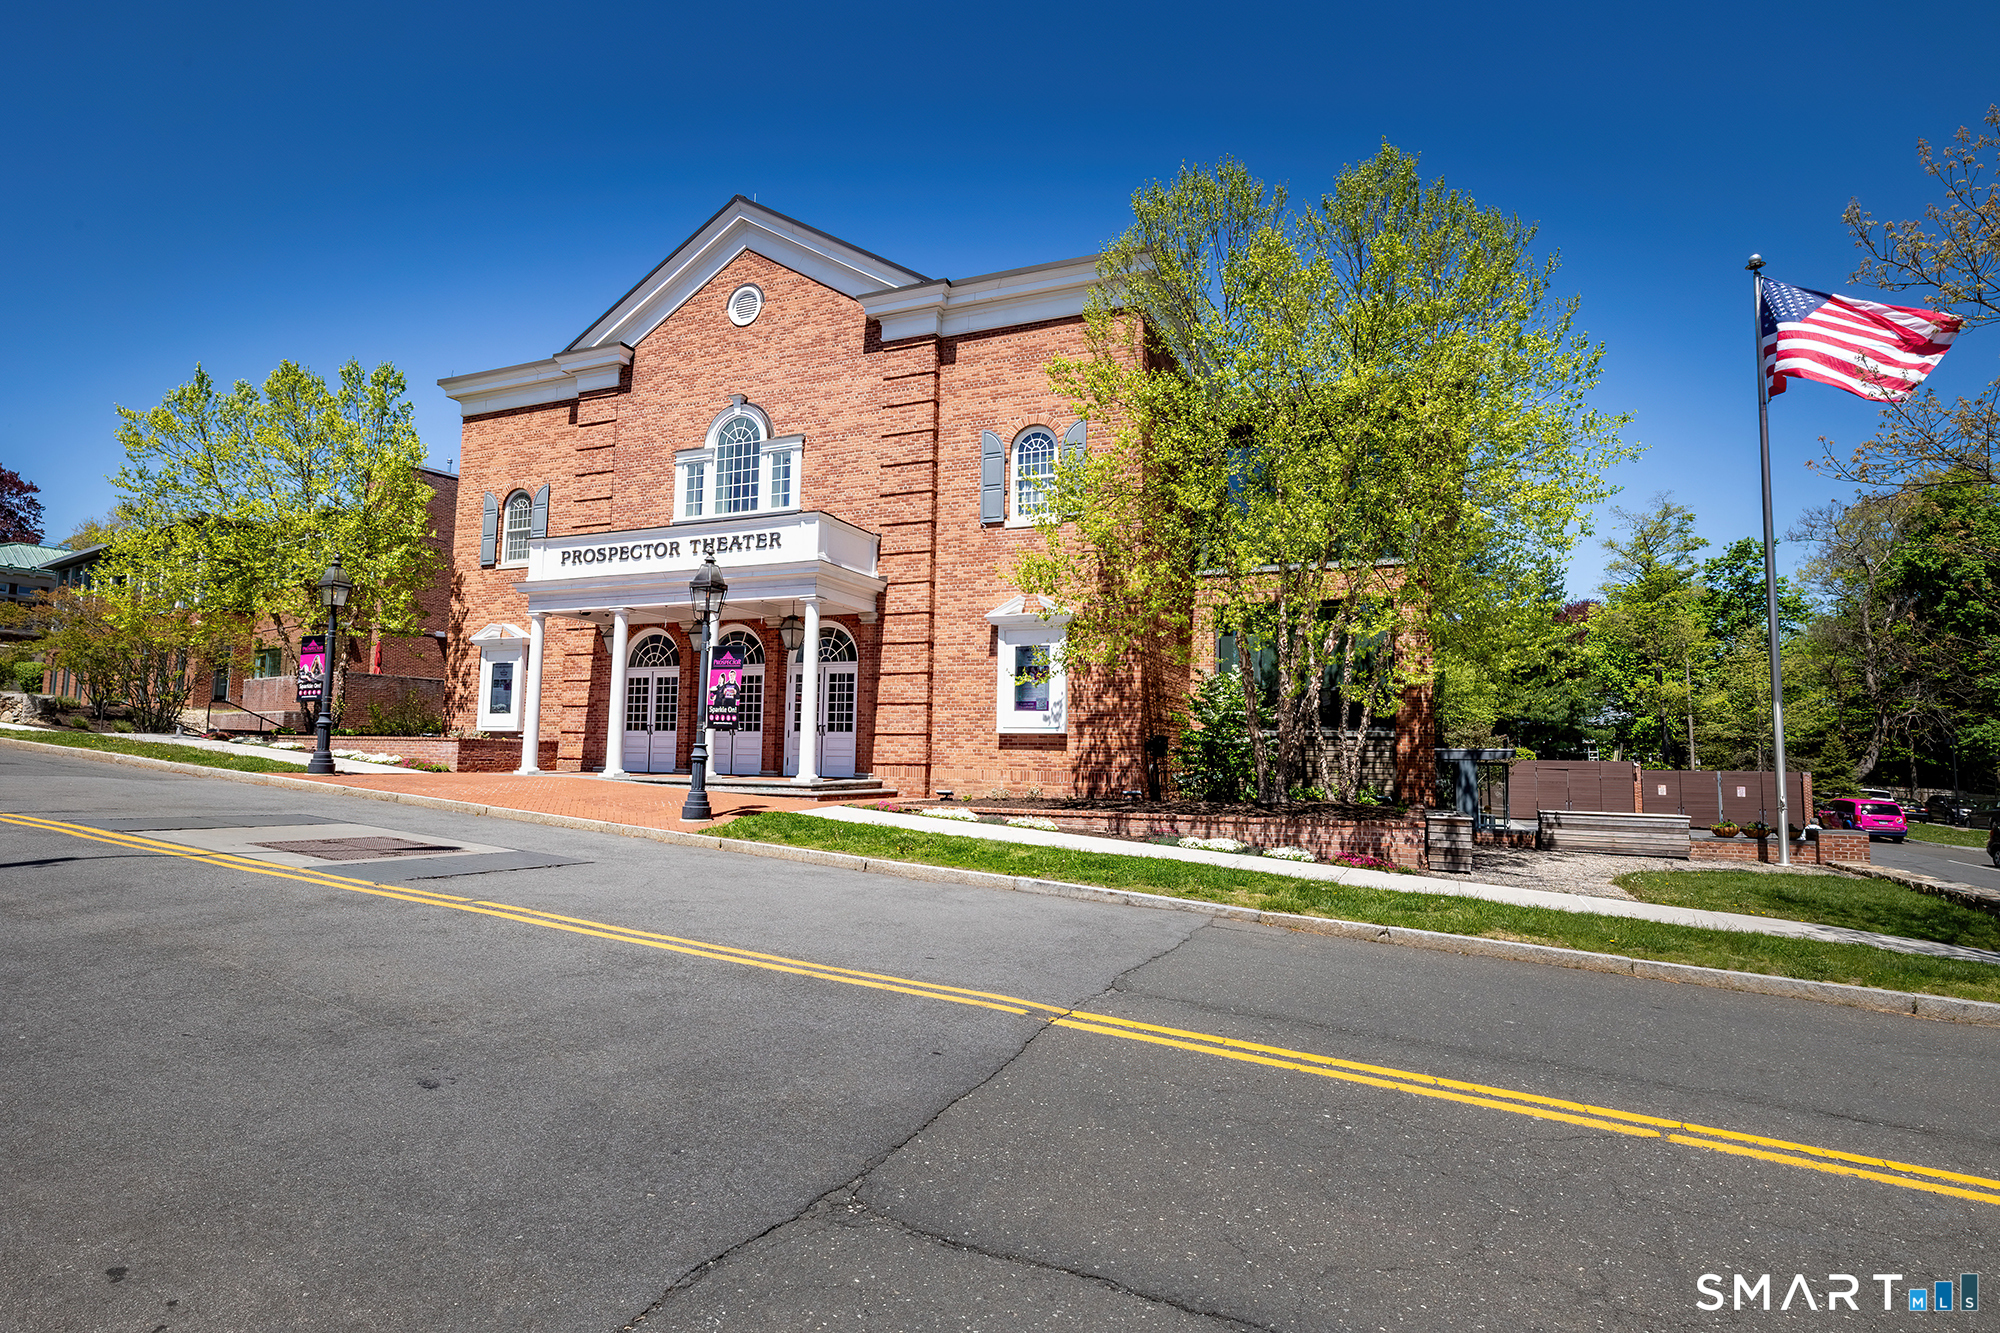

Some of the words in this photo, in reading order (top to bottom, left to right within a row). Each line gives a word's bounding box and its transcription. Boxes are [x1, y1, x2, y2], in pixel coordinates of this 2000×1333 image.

[561, 541, 680, 566] PROSPECTOR
[690, 532, 782, 554] THEATER
[709, 706, 727, 714] Sparkle
